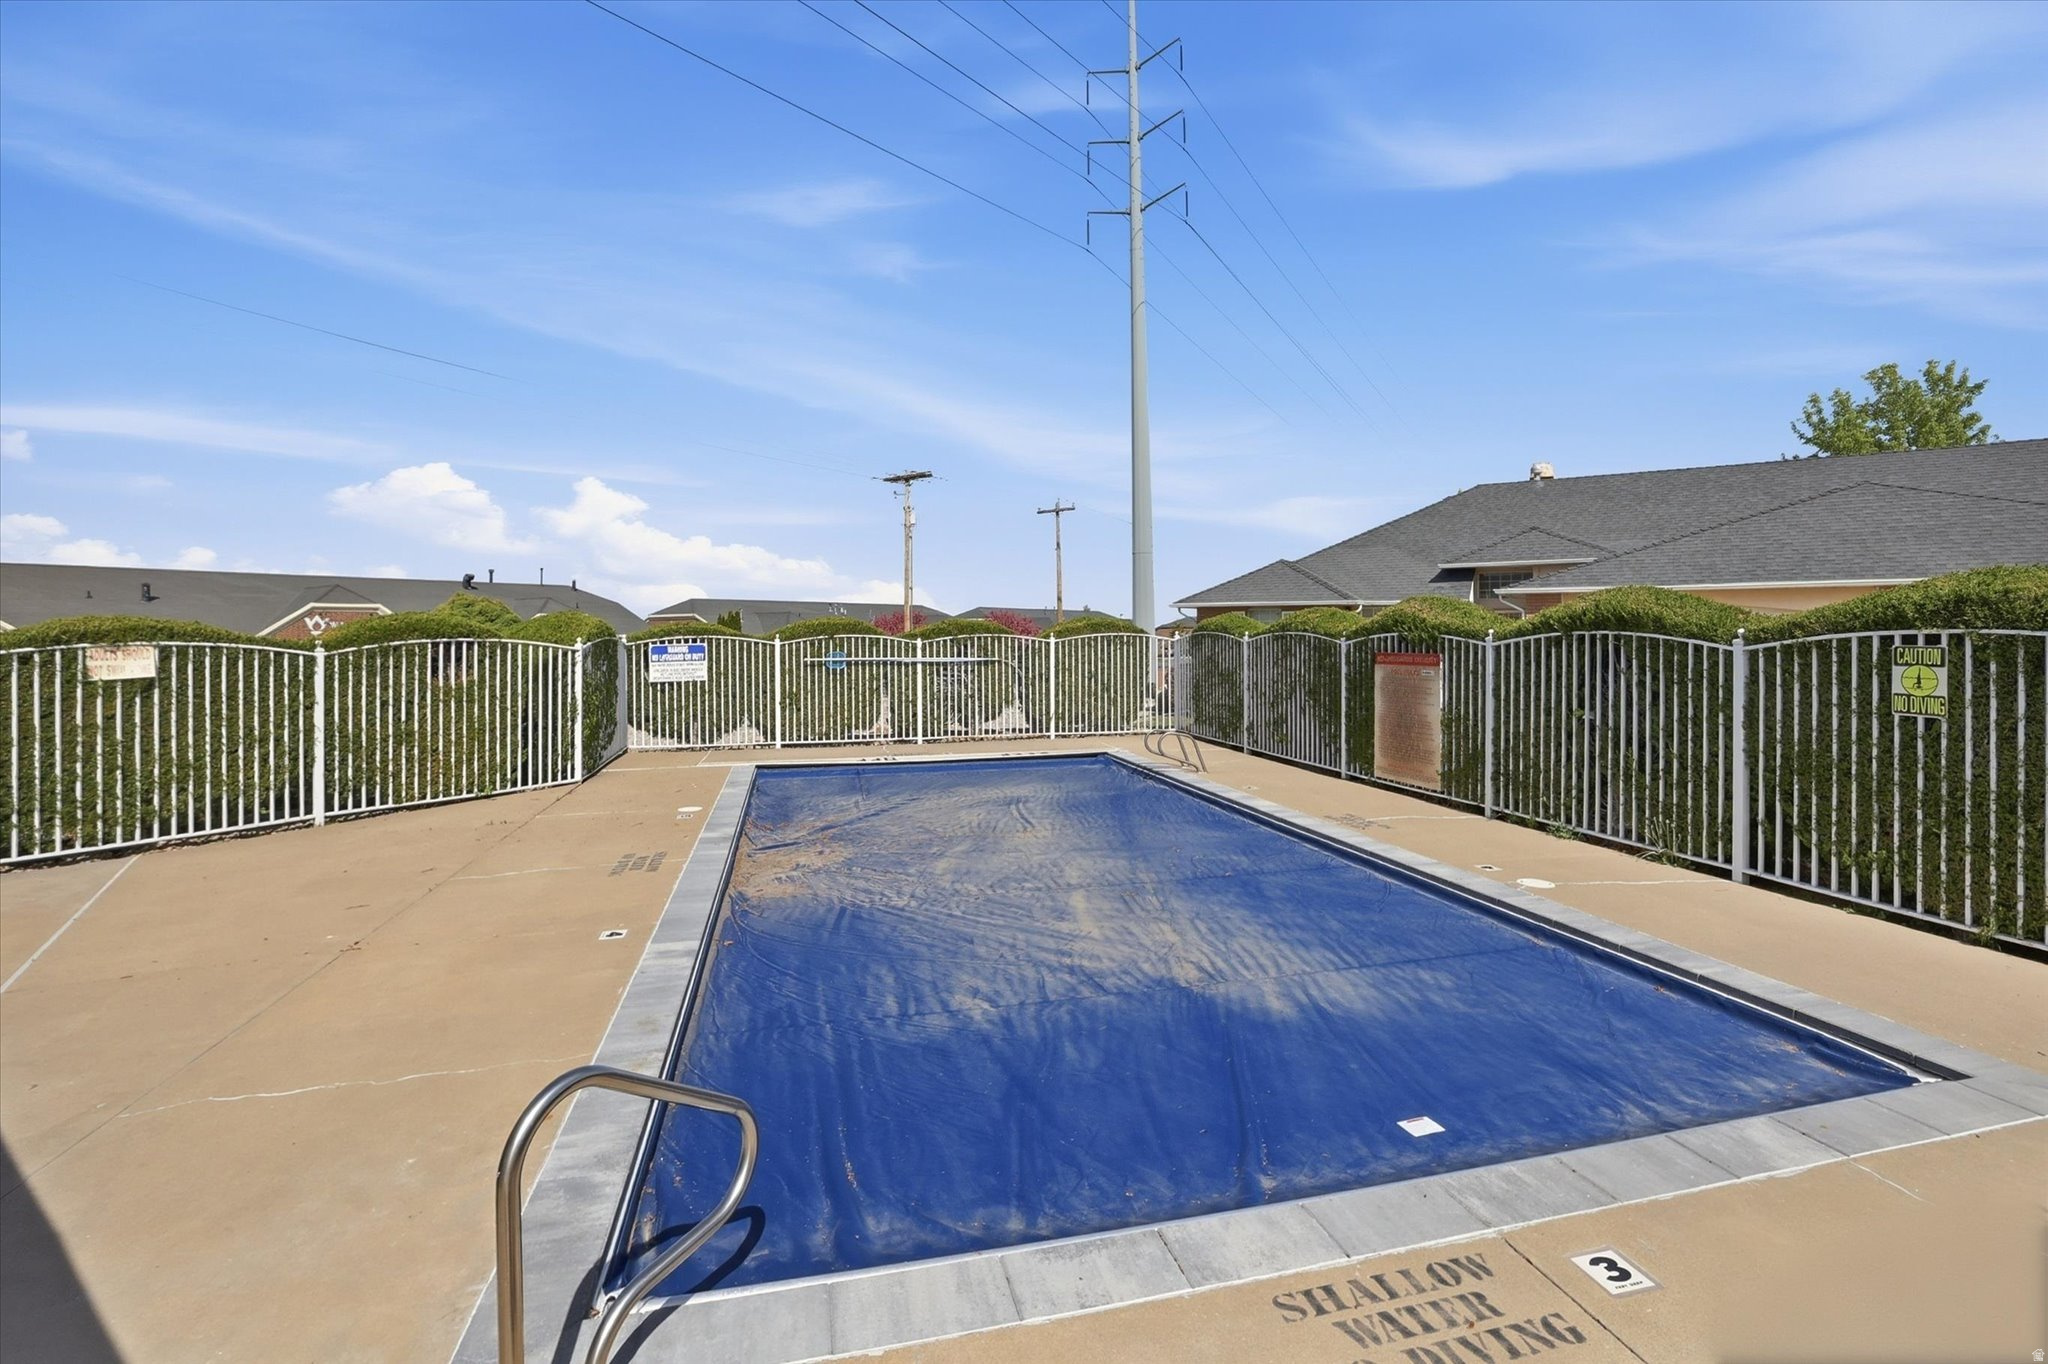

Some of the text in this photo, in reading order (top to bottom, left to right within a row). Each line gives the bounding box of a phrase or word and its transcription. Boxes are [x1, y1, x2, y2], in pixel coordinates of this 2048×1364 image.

[1896, 647, 1941, 665] CAUTION
[1894, 695, 1945, 715] NO DIVING
[1271, 1252, 1495, 1324] SHALLOW
[1589, 1256, 1632, 1282] 3
[1331, 1290, 1506, 1350] WATER
[1400, 1312, 1588, 1364] DIVING
